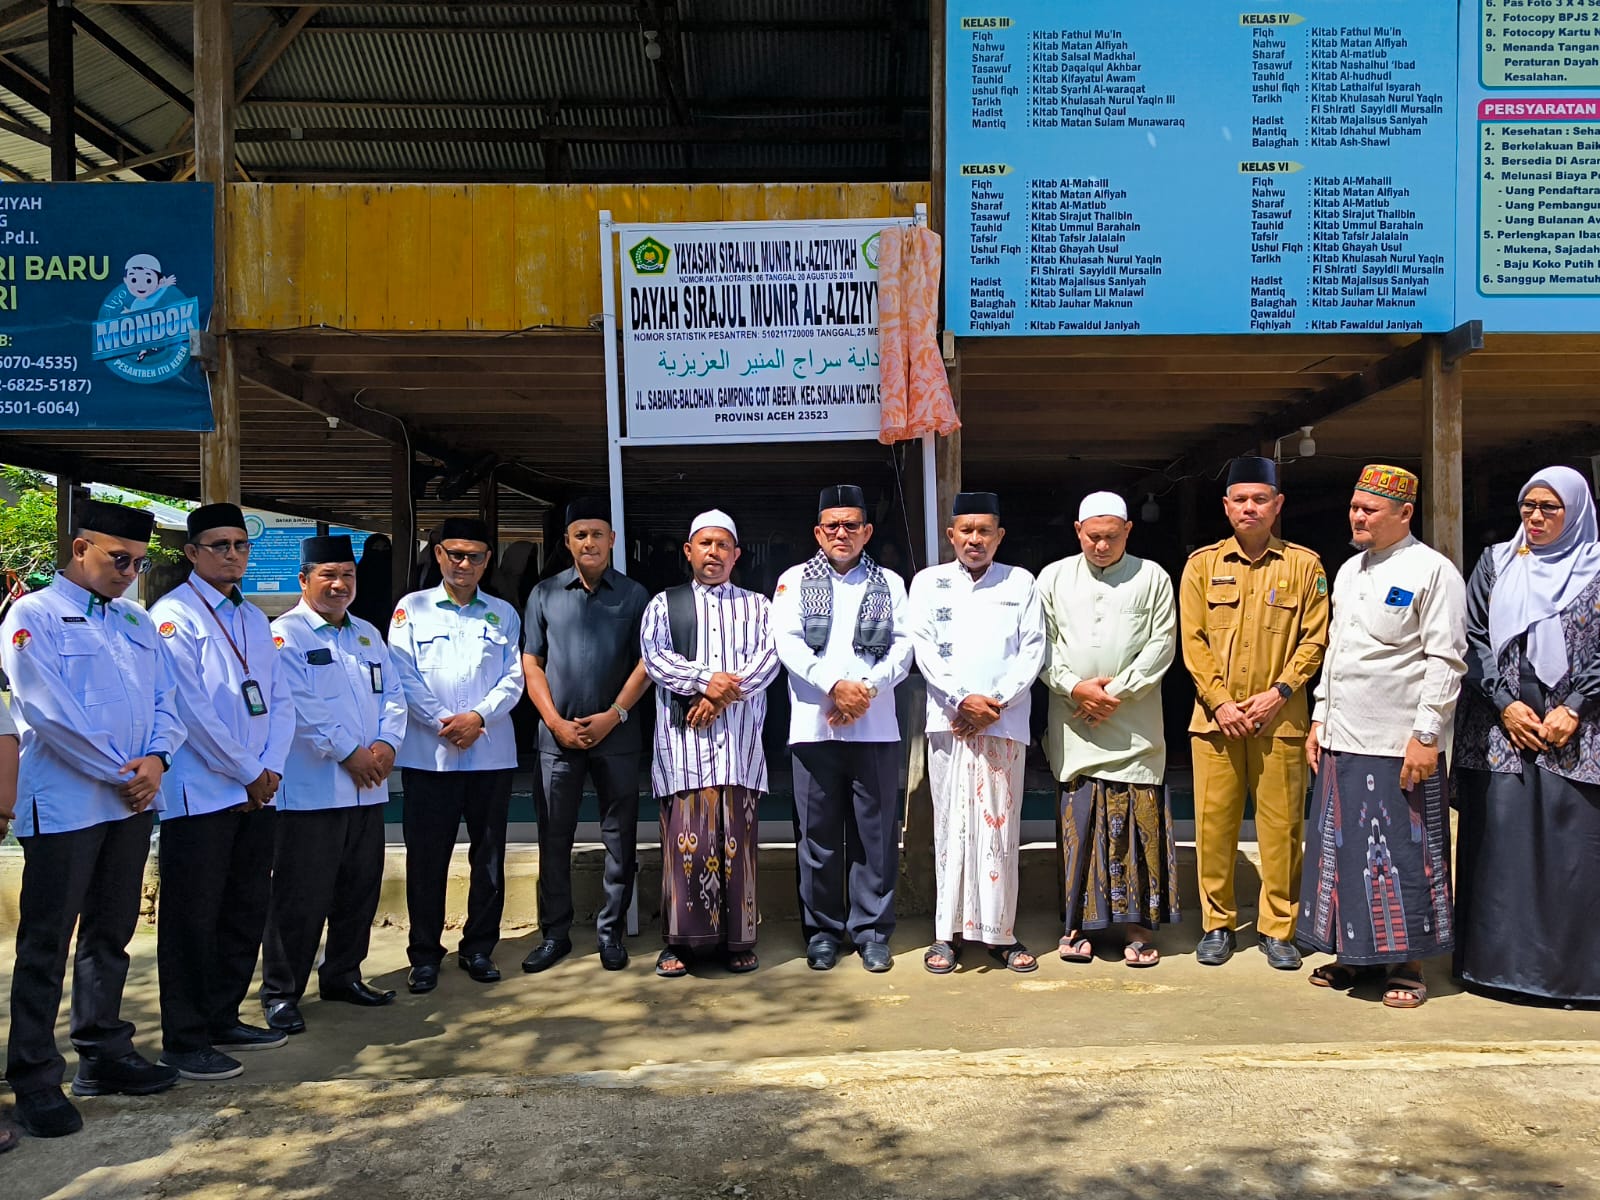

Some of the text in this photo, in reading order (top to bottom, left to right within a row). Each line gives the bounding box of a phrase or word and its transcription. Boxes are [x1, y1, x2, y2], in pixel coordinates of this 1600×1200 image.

[964, 18, 1010, 28] KELAS III
[1242, 14, 1290, 24] KELAS IV
[1486, 13, 1599, 24] 7. Fotocopy BPJS 2
[972, 32, 993, 42] Fiqh
[1032, 30, 1058, 40] Kitab
[1061, 30, 1094, 39] Fathul
[1486, 29, 1496, 37] 8.
[1503, 28, 1555, 38] Fotocopy
[1558, 28, 1590, 36] Kartu
[1486, 43, 1599, 53] 9. Menanda Tangan
[1252, 61, 1292, 70] Tasawuf
[1312, 61, 1338, 70] Kitab
[1504, 58, 1598, 68] Peraturan Dayah
[1504, 72, 1568, 81] Kesalahan.
[1252, 83, 1280, 92] ushul
[1282, 83, 1300, 94] fiqh
[1312, 83, 1338, 92] Kitab
[1386, 83, 1421, 94] Isyarah
[972, 97, 1001, 106] Tarikh
[1032, 96, 1058, 106] Kitab
[1061, 96, 1106, 105] Khulasah
[1109, 96, 1135, 104] Nurul
[1137, 95, 1164, 107] Yaqin
[1484, 104, 1596, 115] PERSYARATAN
[972, 119, 1006, 129] Mantiq
[1032, 118, 1058, 128] Kitab
[1061, 118, 1092, 127] Matan
[1128, 118, 1185, 128] Munawaraq
[1484, 127, 1495, 135] 1.
[1502, 127, 1562, 135] Kesehatan
[1252, 138, 1390, 149] Balaghah Kitab Ash-Shawi
[1484, 142, 1494, 150] 2.
[1502, 142, 1573, 150] Berkelakuan
[1484, 157, 1494, 165] 3.
[1502, 156, 1552, 165] Bersedia
[1556, 156, 1567, 165] Di
[962, 165, 1006, 174] KELAS V
[1242, 162, 1289, 172] KELAS VI
[1484, 172, 1494, 180] 4.
[1502, 172, 1552, 180] Melunasi
[1556, 172, 1587, 181] Biaya
[1506, 186, 1535, 196] Uang
[971, 202, 1003, 211] Sharaf
[1032, 202, 1057, 210] Kitab
[1506, 201, 1600, 211] Uang Pembangu
[1252, 221, 1423, 230] Tauhid Kitab Ummul Barahain
[1506, 216, 1534, 226] Uang
[1538, 216, 1584, 224] Bulanan
[1484, 231, 1494, 239] 5.
[1498, 230, 1575, 240] Perlengkapan
[1504, 245, 1551, 255] Mukena,
[674, 239, 857, 274] YAYASAN SIRAJUL MUNIR AL-AZIZIYYAH
[26, 256, 109, 280] BARU
[1504, 260, 1529, 270] Baju
[1532, 260, 1561, 268] Koko
[1565, 260, 1594, 268] Putih
[680, 275, 704, 283] NOMOR
[970, 278, 1146, 289] Hadist Kitab Majalisus Saniyah
[1483, 275, 1493, 284] 6.
[1497, 275, 1546, 285] Sanggup
[1251, 288, 1285, 298] Mantiq
[1313, 287, 1339, 296] Kitab
[1392, 287, 1427, 296] Malawi
[631, 286, 680, 330] DAYAH
[684, 284, 746, 329] SIRAJUL
[750, 282, 799, 328] MUNIR
[970, 310, 1014, 320] Qawaidul
[96, 304, 194, 352] MONDOK
[970, 320, 1140, 332] Fiqhiyah Kitab Fawaidul Janiyah
[634, 333, 665, 341] NOMOR
[667, 332, 707, 340] STATISTIK
[868, 328, 879, 336] ME
[658, 348, 729, 377] العزيزية
[738, 348, 784, 376] المنير
[792, 348, 841, 379] سراج
[0, 378, 92, 394] -6825-5187)
[636, 390, 646, 411] JL.
[718, 386, 754, 408] GAMPONG
[756, 386, 770, 407] COT
[856, 384, 876, 404] KOTA
[715, 410, 829, 423] PROVINSI ACEH 23523
